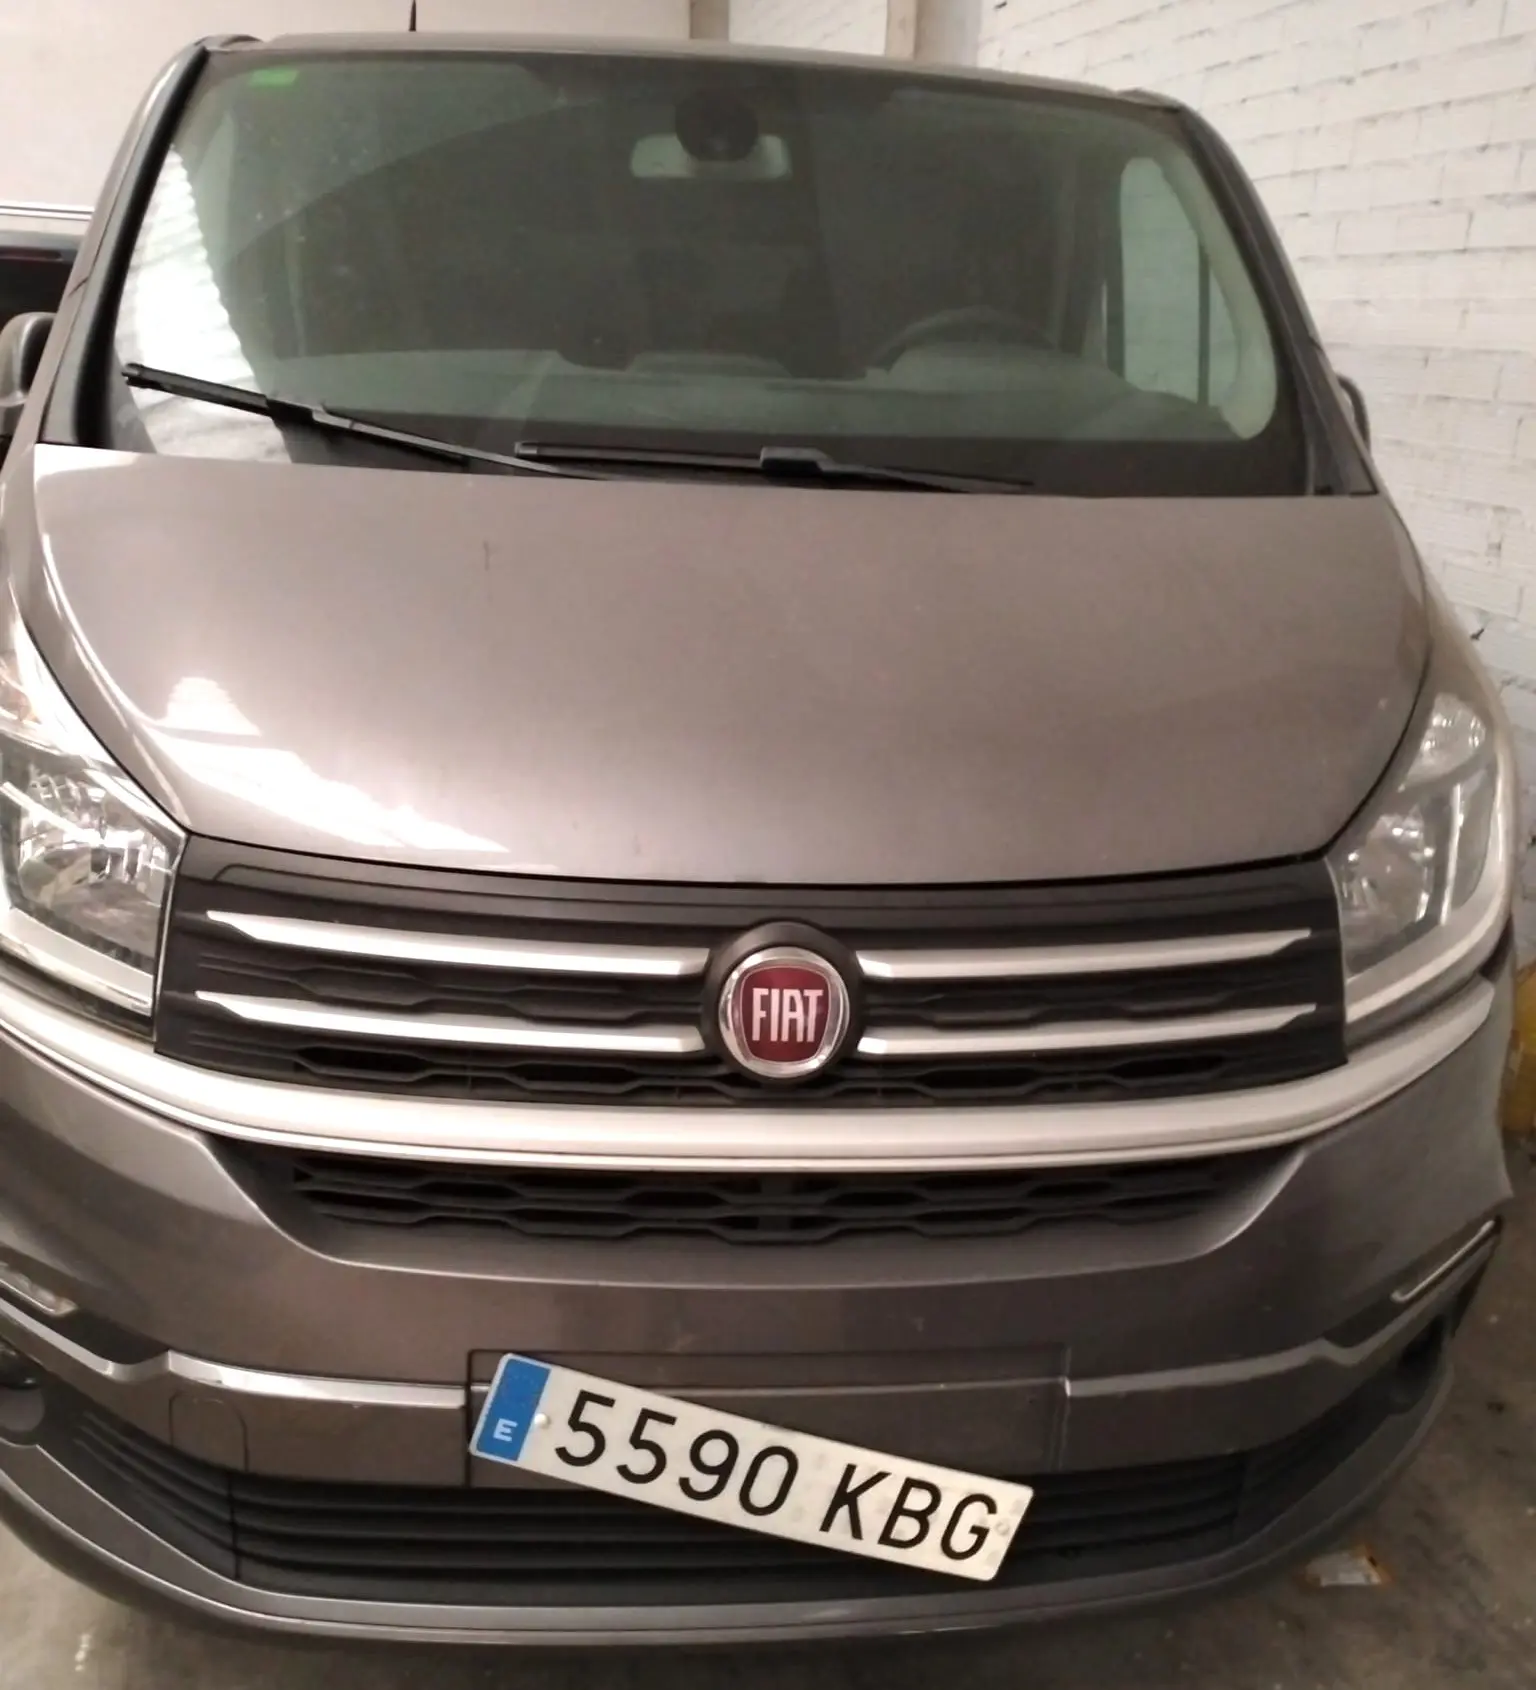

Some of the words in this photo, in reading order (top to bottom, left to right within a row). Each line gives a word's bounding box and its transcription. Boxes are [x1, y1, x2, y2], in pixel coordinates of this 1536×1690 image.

[752, 988, 824, 1042] FIAT
[493, 1418, 517, 1442] E
[555, 1389, 800, 1517] 5590
[819, 1463, 998, 1561] KBG
